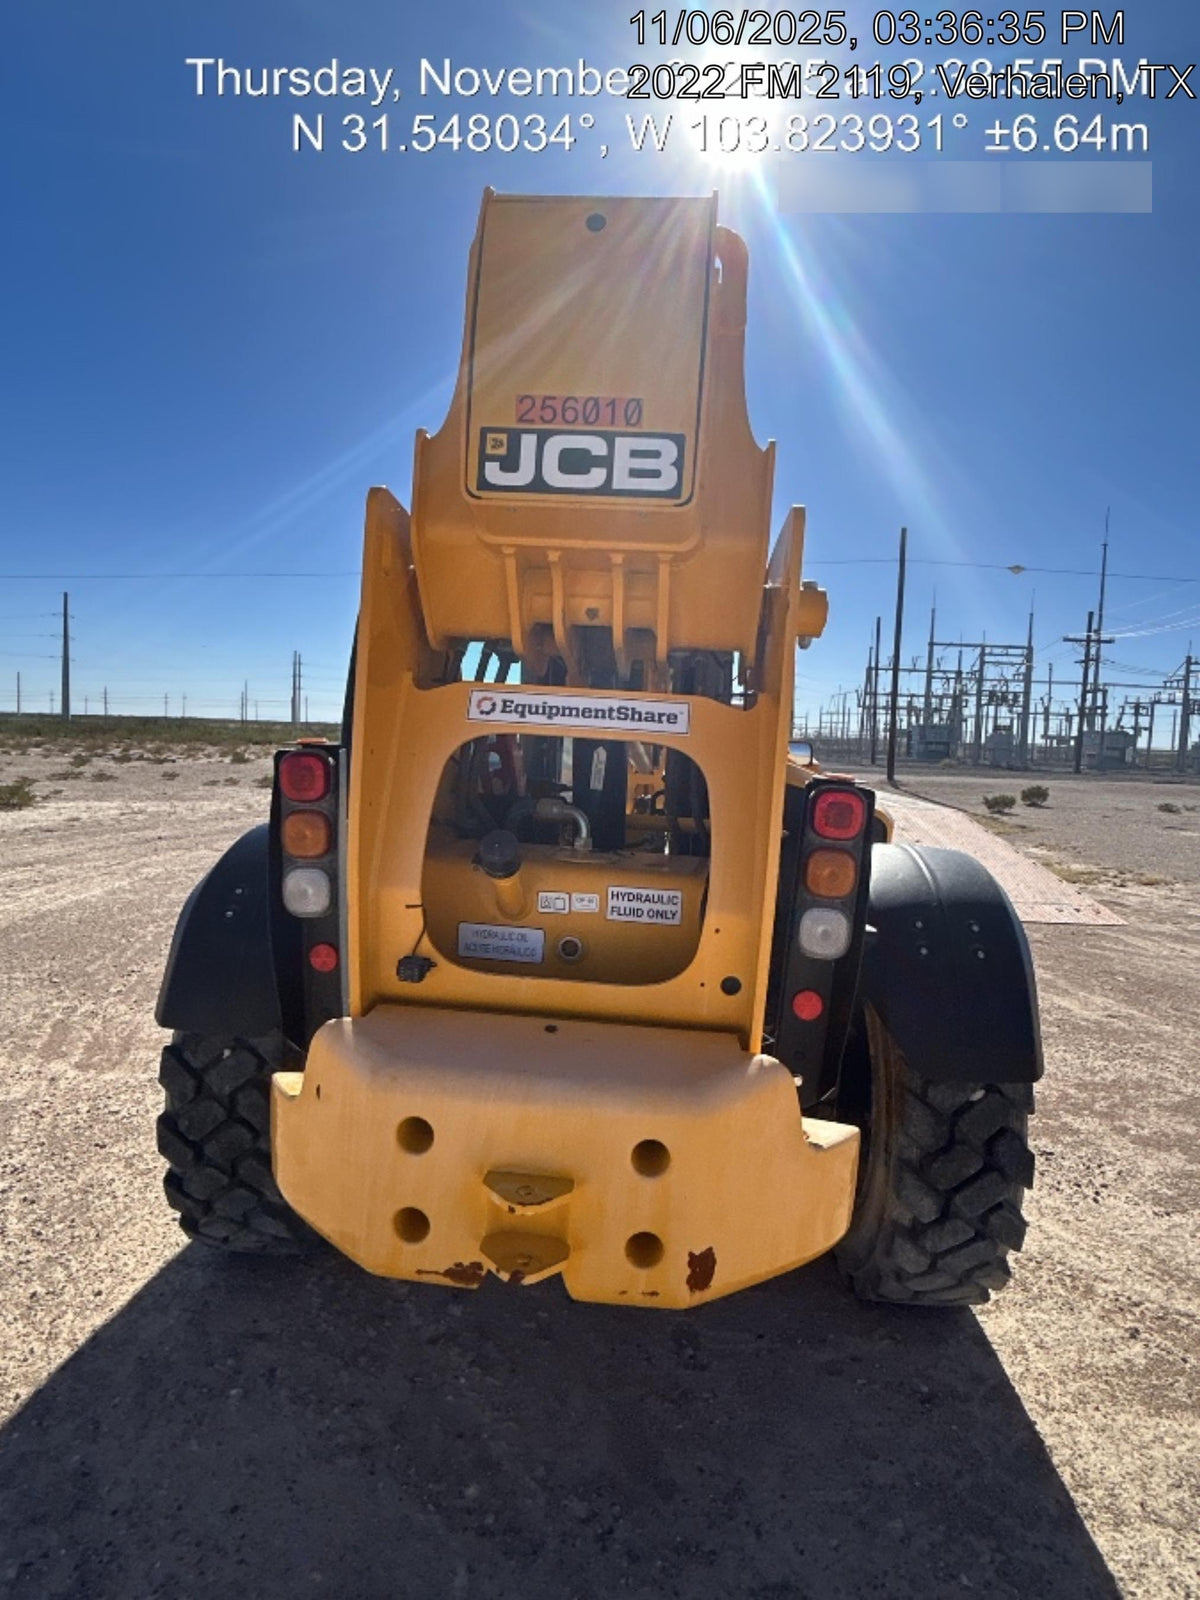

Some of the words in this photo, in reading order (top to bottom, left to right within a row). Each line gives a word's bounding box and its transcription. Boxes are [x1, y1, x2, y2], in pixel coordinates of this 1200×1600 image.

[517, 395, 643, 426] 256010
[484, 433, 679, 491] JCB
[501, 698, 679, 725] EquipmentShare
[610, 890, 680, 906] HYDRAULIC
[610, 905, 645, 918] FLUID
[647, 907, 679, 920] ONLY
